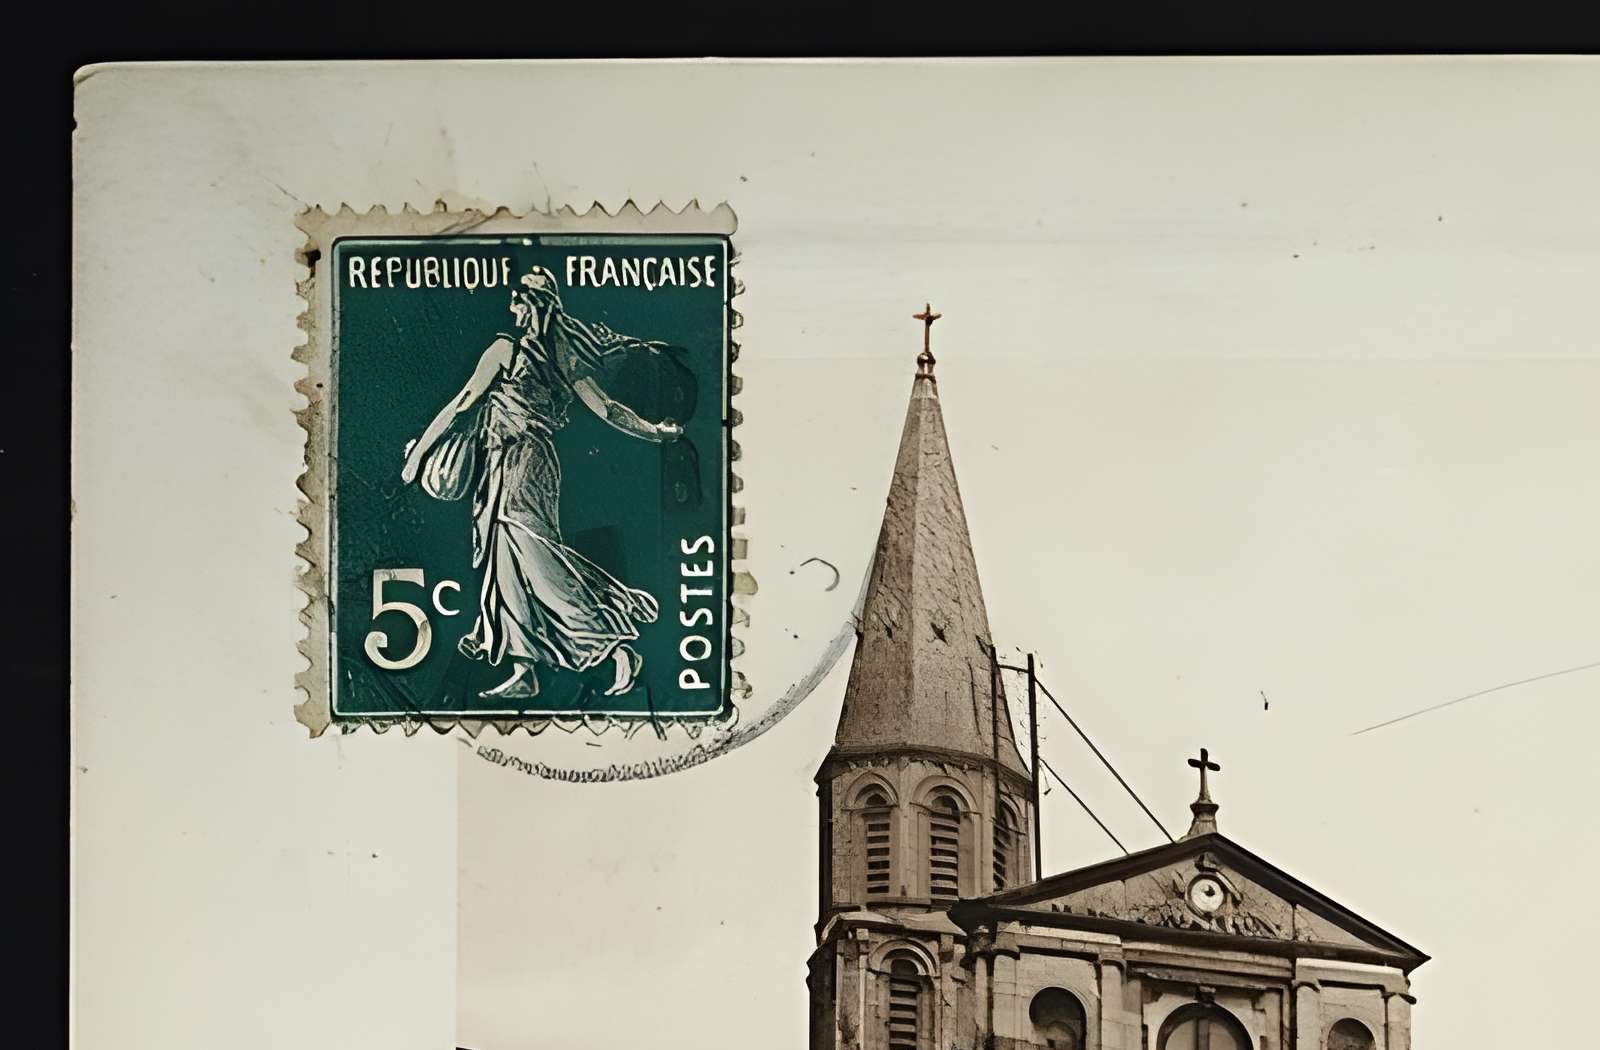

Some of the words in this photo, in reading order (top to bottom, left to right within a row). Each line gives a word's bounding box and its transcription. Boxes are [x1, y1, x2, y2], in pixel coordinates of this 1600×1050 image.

[348, 255, 511, 294] REPUBLIQUE
[565, 255, 716, 291] FRANÇAISE
[678, 535, 715, 690] POSTES
